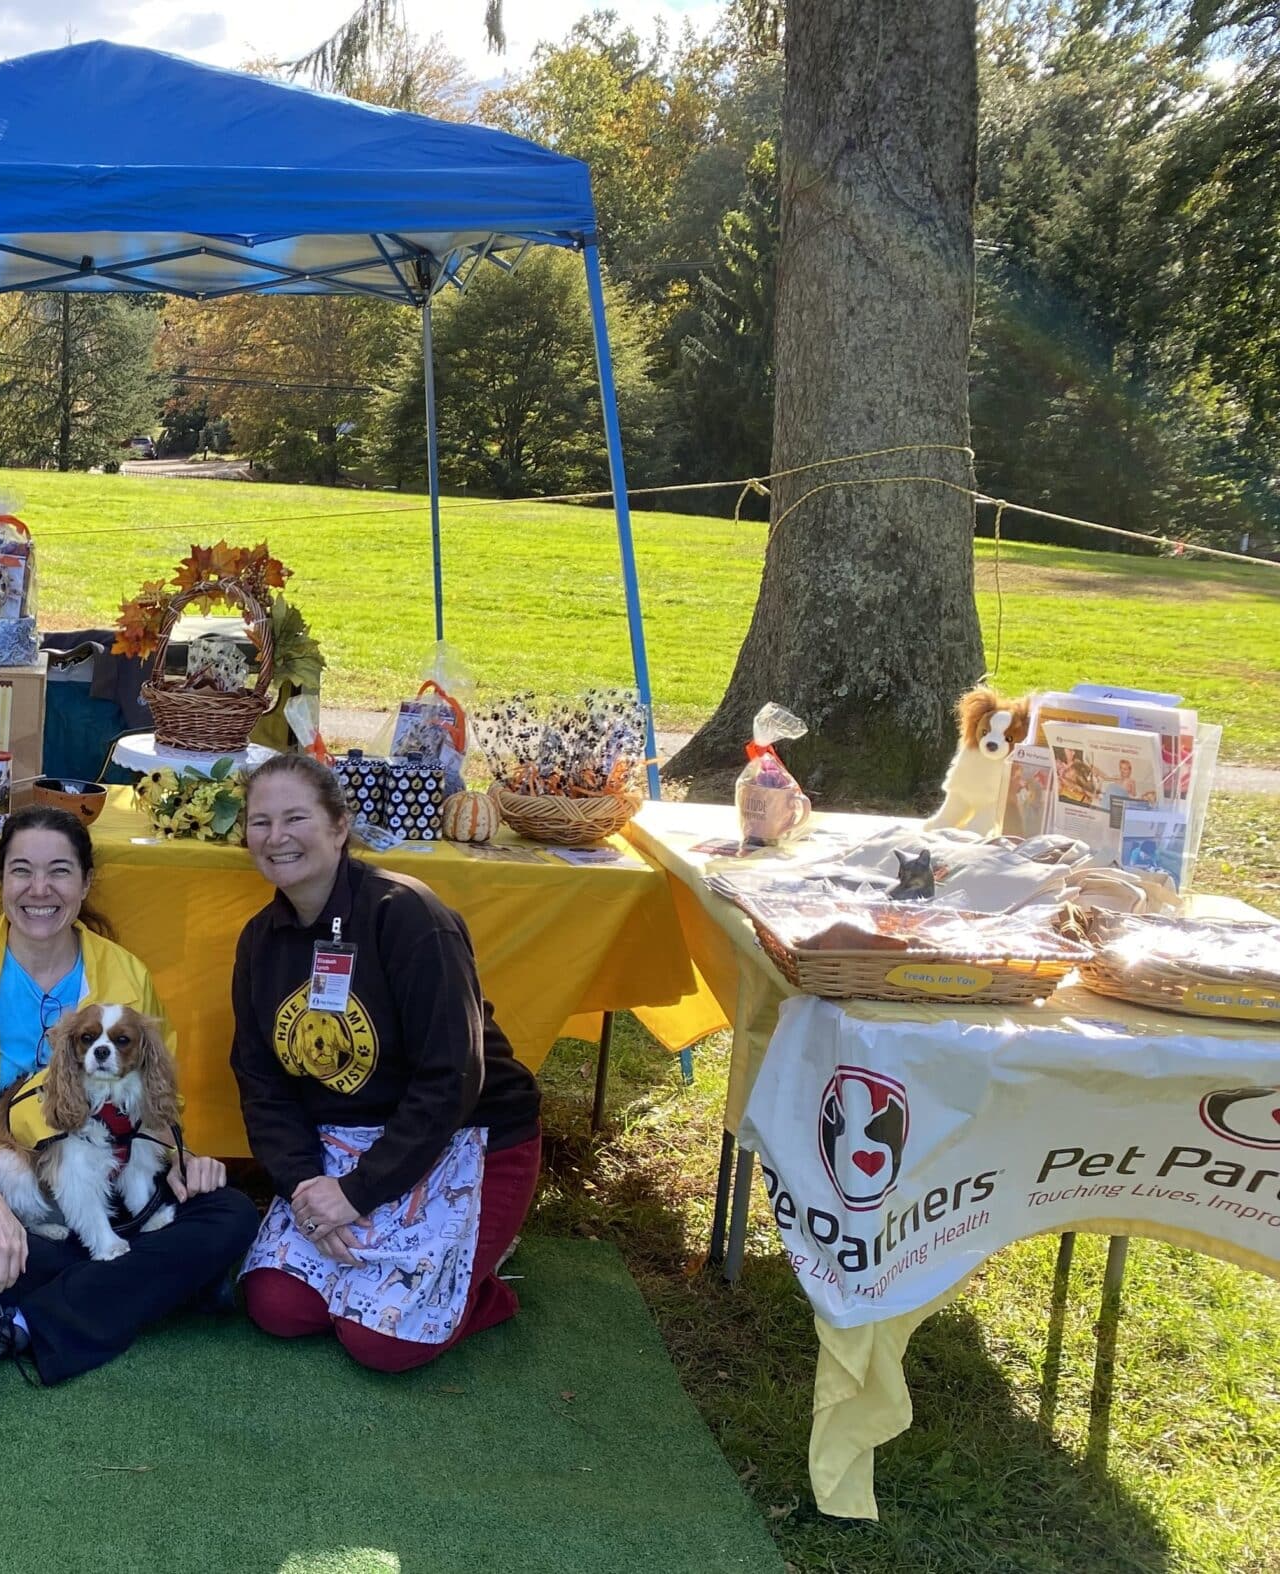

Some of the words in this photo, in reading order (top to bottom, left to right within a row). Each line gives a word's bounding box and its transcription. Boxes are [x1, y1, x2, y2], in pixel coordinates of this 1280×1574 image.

[903, 971, 935, 984] Treats
[938, 974, 953, 984] for
[956, 975, 977, 985] You
[1194, 991, 1233, 1004] Treats
[1238, 996, 1254, 1006] for
[277, 1001, 300, 1041] HAVE
[347, 1010, 367, 1034] MY
[1036, 1145, 1145, 1184] Pet
[1156, 1146, 1280, 1199] Par
[1027, 1183, 1126, 1208] Touching
[1131, 1183, 1202, 1206] Lives,
[762, 1165, 805, 1235] Pe
[807, 1169, 999, 1274] Partners
[933, 1210, 990, 1251] Health
